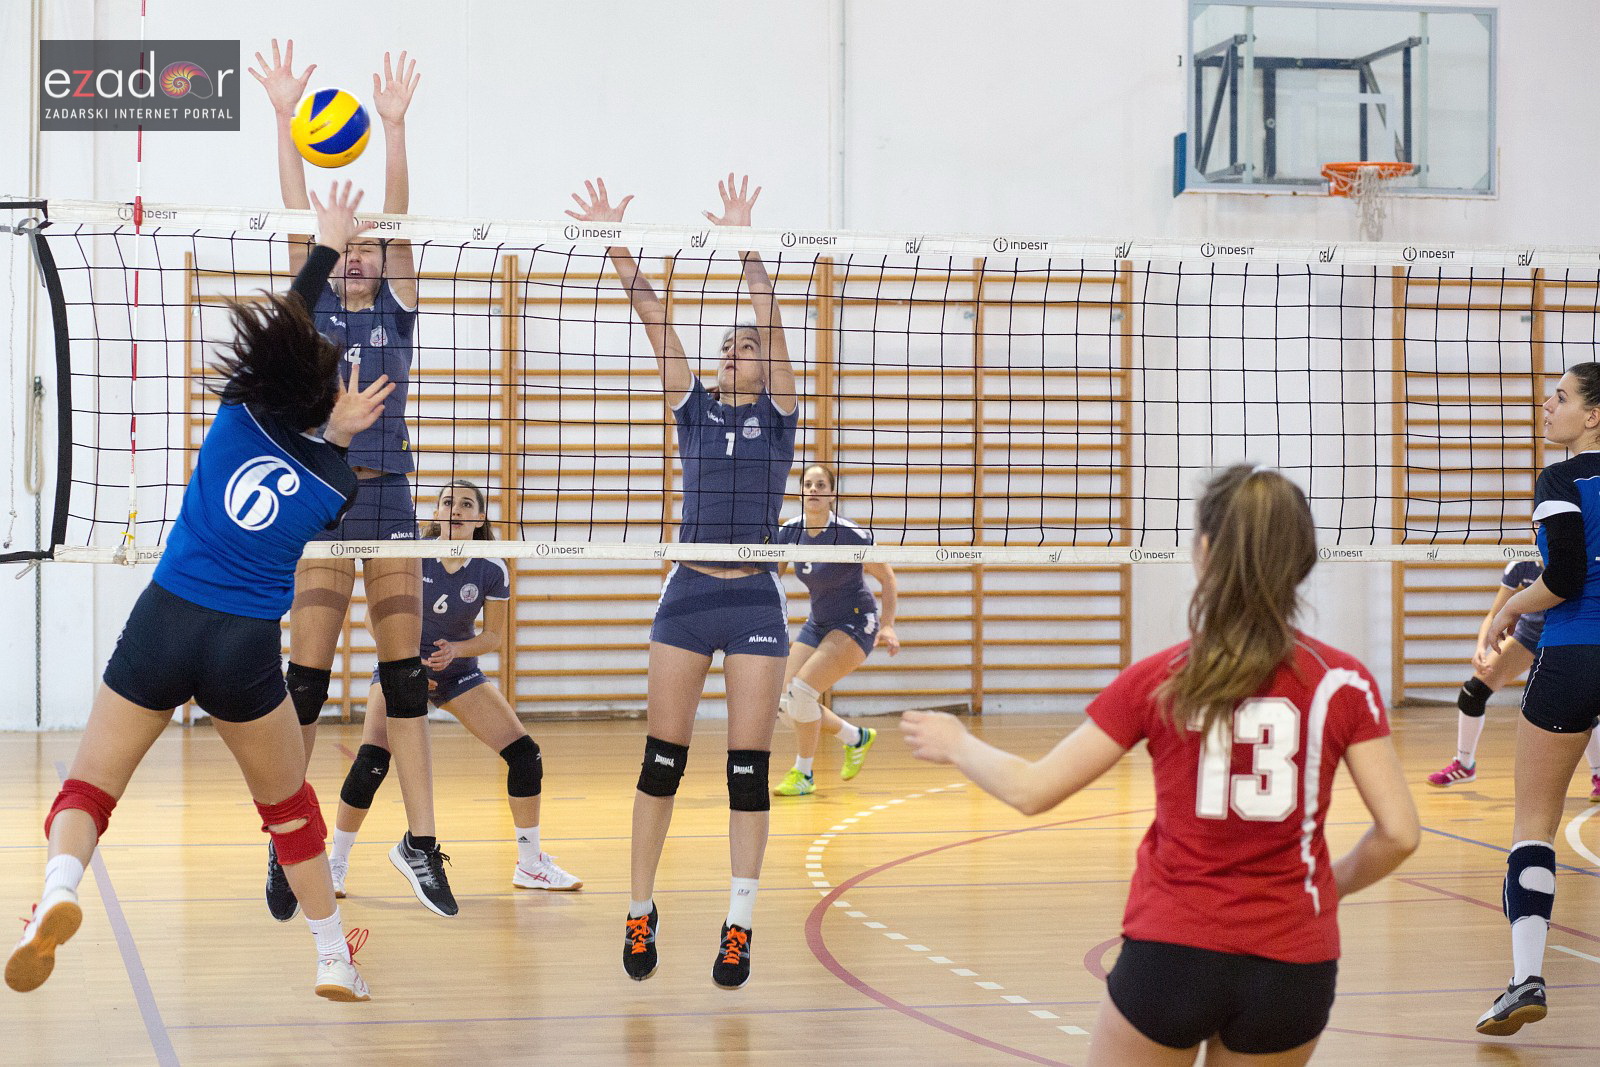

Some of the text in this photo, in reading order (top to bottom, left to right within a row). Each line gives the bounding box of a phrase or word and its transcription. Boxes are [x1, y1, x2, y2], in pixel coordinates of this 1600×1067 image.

[344, 343, 361, 365] 4
[224, 455, 300, 531] 6
[432, 593, 449, 614] 6
[1186, 696, 1301, 823] 13
